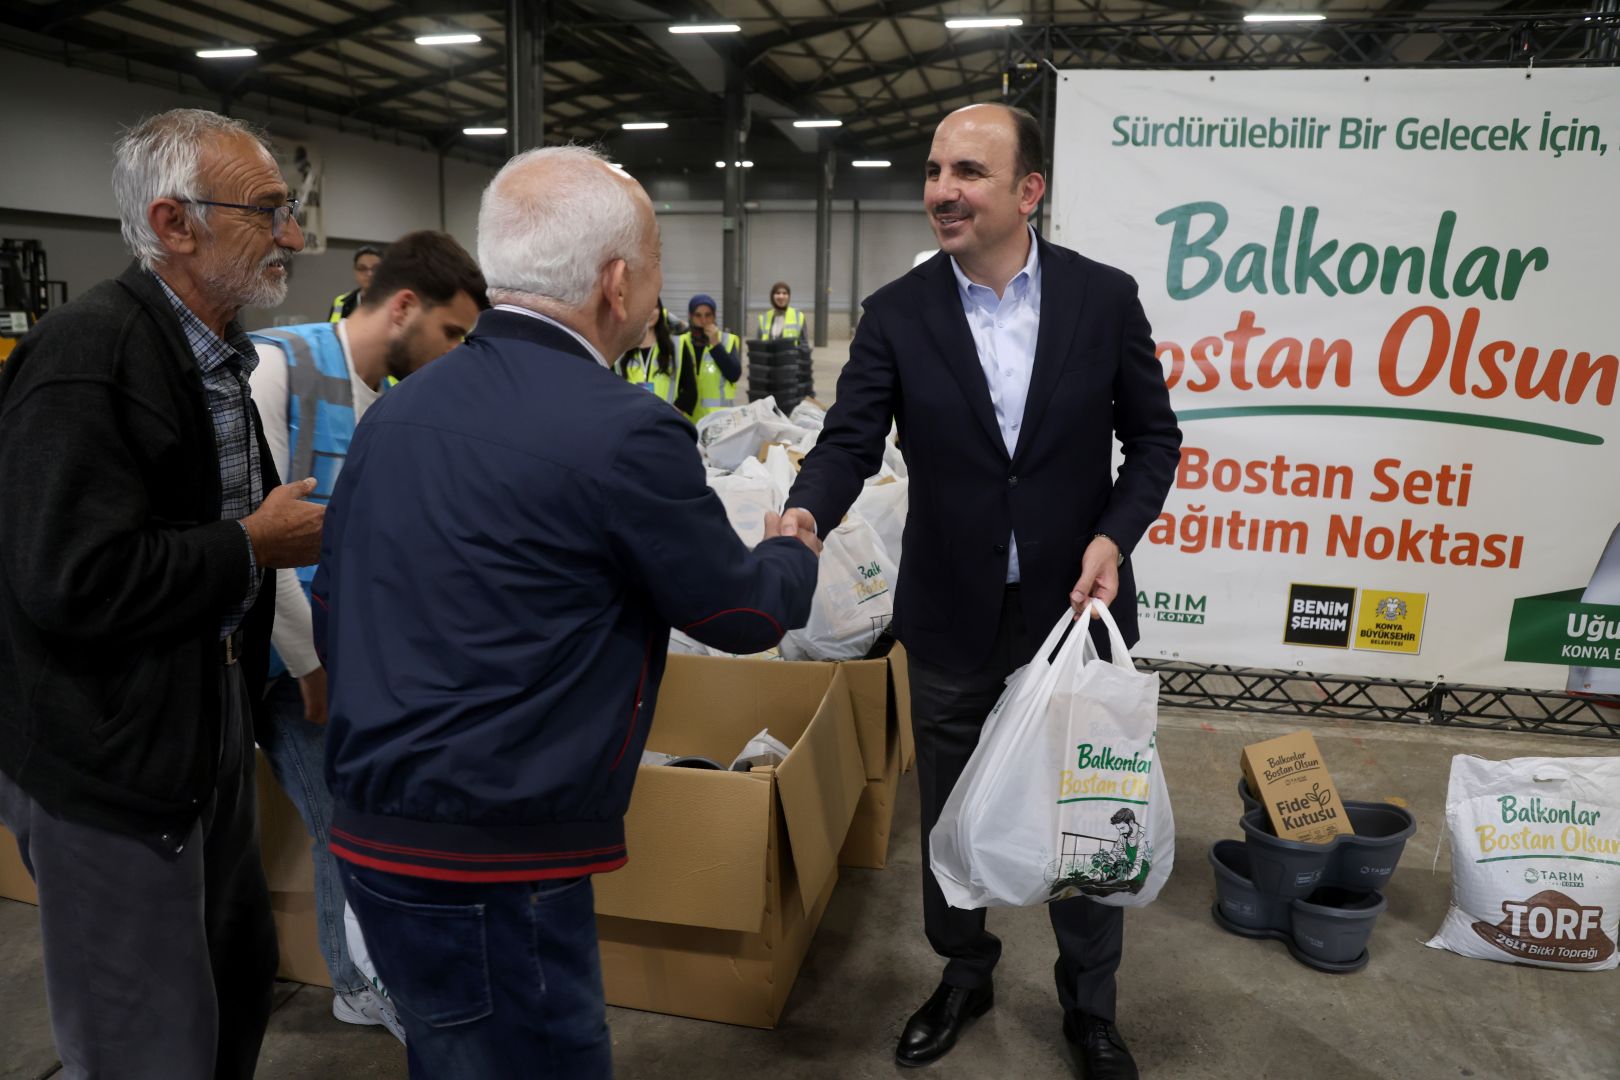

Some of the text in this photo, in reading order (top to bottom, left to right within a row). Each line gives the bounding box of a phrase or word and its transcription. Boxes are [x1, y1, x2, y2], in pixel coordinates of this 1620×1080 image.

[1112, 111, 1608, 158] Sürdürülebilir Bir Gelecek İçin,
[1155, 201, 1549, 300] Balkonlar
[1155, 305, 1620, 406] ostan Olsun
[1176, 447, 1474, 507] Bostan Seti
[1148, 504, 1525, 570] ağıtım Noktası
[1136, 590, 1207, 612] ARIM
[1292, 598, 1349, 617] BENİM
[1159, 612, 1203, 624] KONYA
[1291, 616, 1347, 632] ŞEHRİM
[1375, 622, 1403, 631] KONYA
[1566, 613, 1620, 642] Uğu
[1561, 644, 1610, 660] KONYA
[1263, 766, 1294, 782] Bostan
[1294, 759, 1319, 771] Olsun
[1267, 751, 1306, 769] Balkonlar
[1060, 769, 1117, 797] Bostan
[1276, 797, 1311, 816] Fide
[1497, 794, 1601, 826] Balkonlar
[1282, 807, 1337, 831] Kutusu
[1475, 824, 1555, 853] Bostan
[1540, 870, 1584, 882] TARIM
[1505, 903, 1600, 940] TORF
[1528, 944, 1556, 956] Bitki
[1557, 947, 1598, 959] Toprağı
